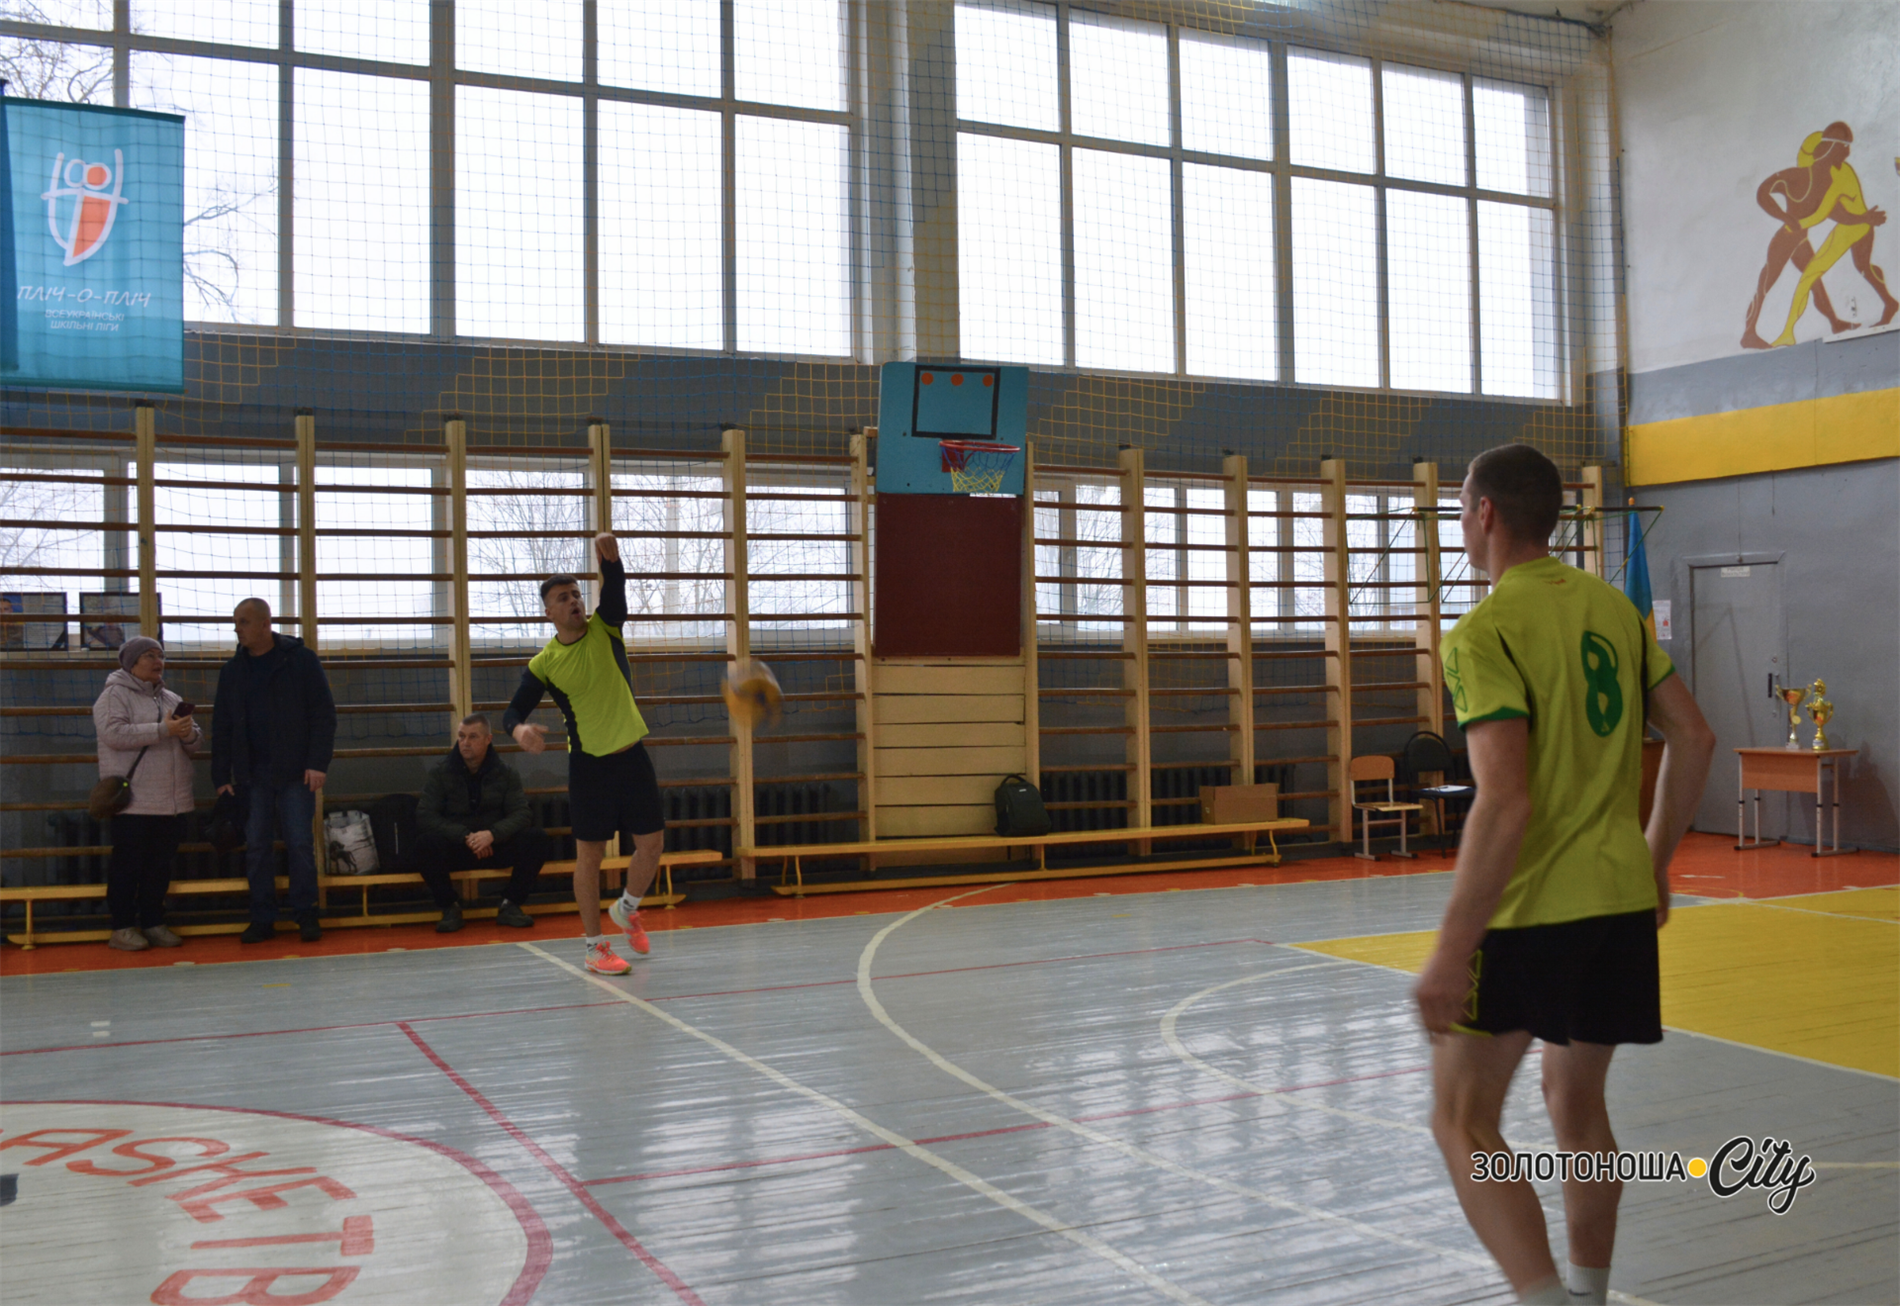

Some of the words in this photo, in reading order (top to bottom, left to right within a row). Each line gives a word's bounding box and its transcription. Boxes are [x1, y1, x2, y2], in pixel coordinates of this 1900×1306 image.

[17, 285, 152, 307] ПЛІЧ-О-ПЛІЧ
[45, 309, 125, 322] ВСЕУКРАЇНСЬКІ
[51, 320, 93, 331] ШКІЛЬНІ
[95, 322, 120, 332] ЛІГИ
[1580, 629, 1624, 738] 8
[0, 1127, 376, 1306] ASKETB
